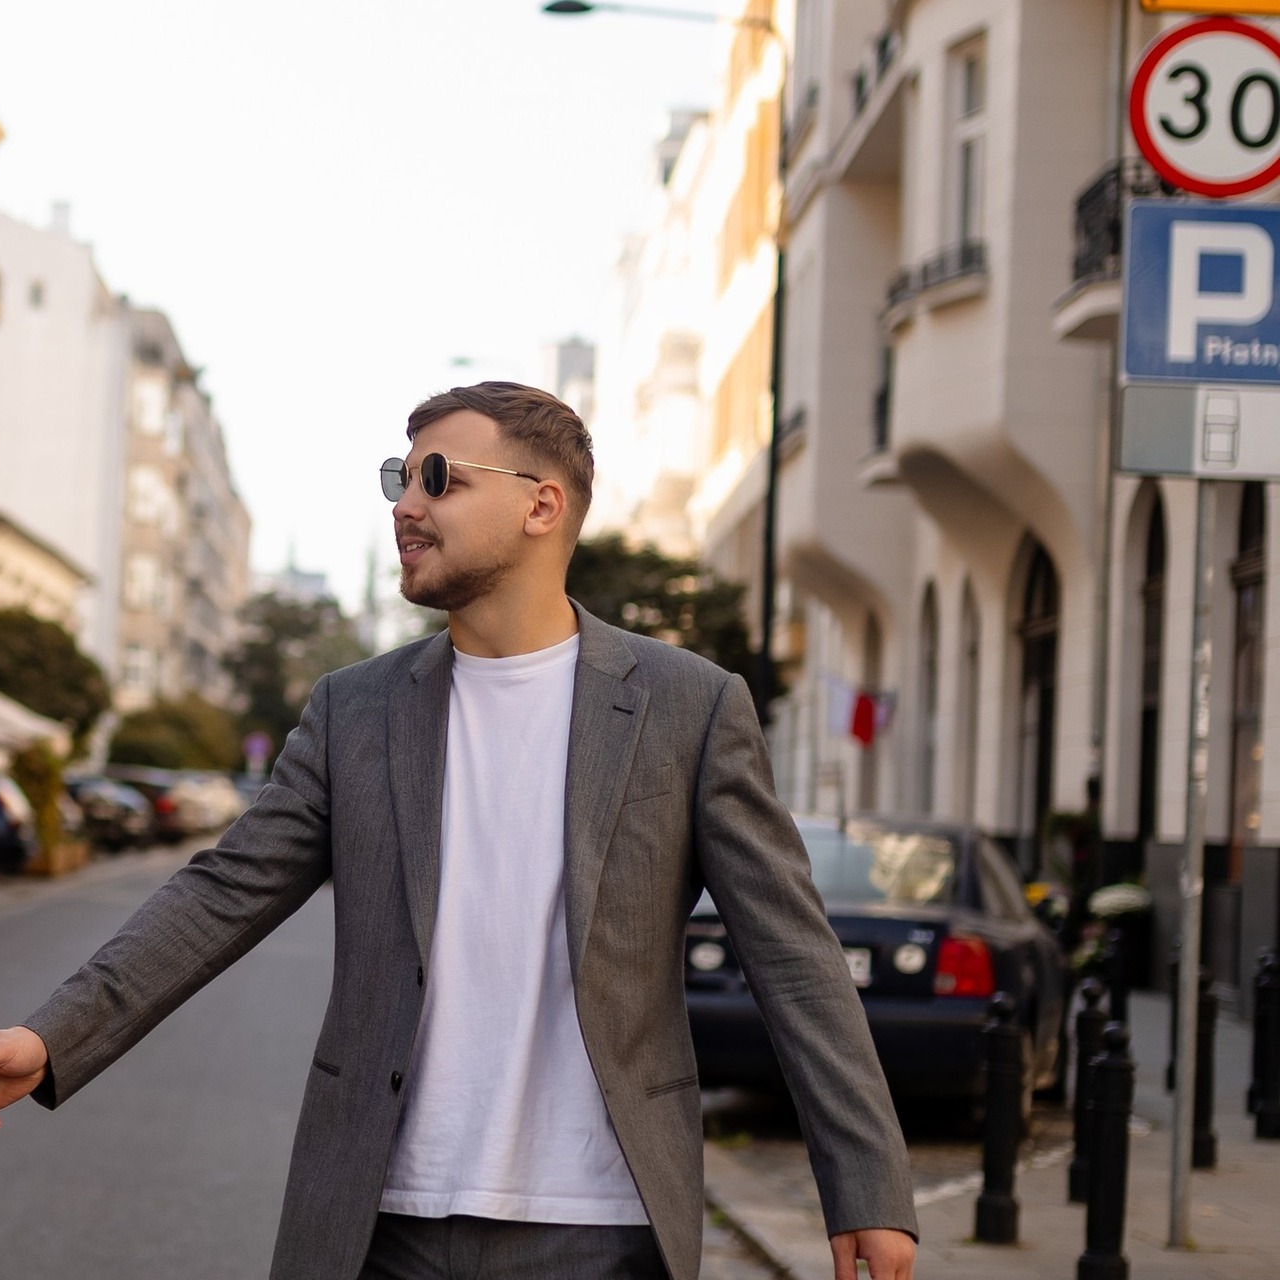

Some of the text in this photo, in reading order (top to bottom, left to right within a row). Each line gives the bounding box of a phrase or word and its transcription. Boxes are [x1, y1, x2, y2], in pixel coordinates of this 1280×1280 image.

[1159, 65, 1280, 149] 30
[1167, 221, 1275, 363] P
[1204, 336, 1280, 367] Płatn
